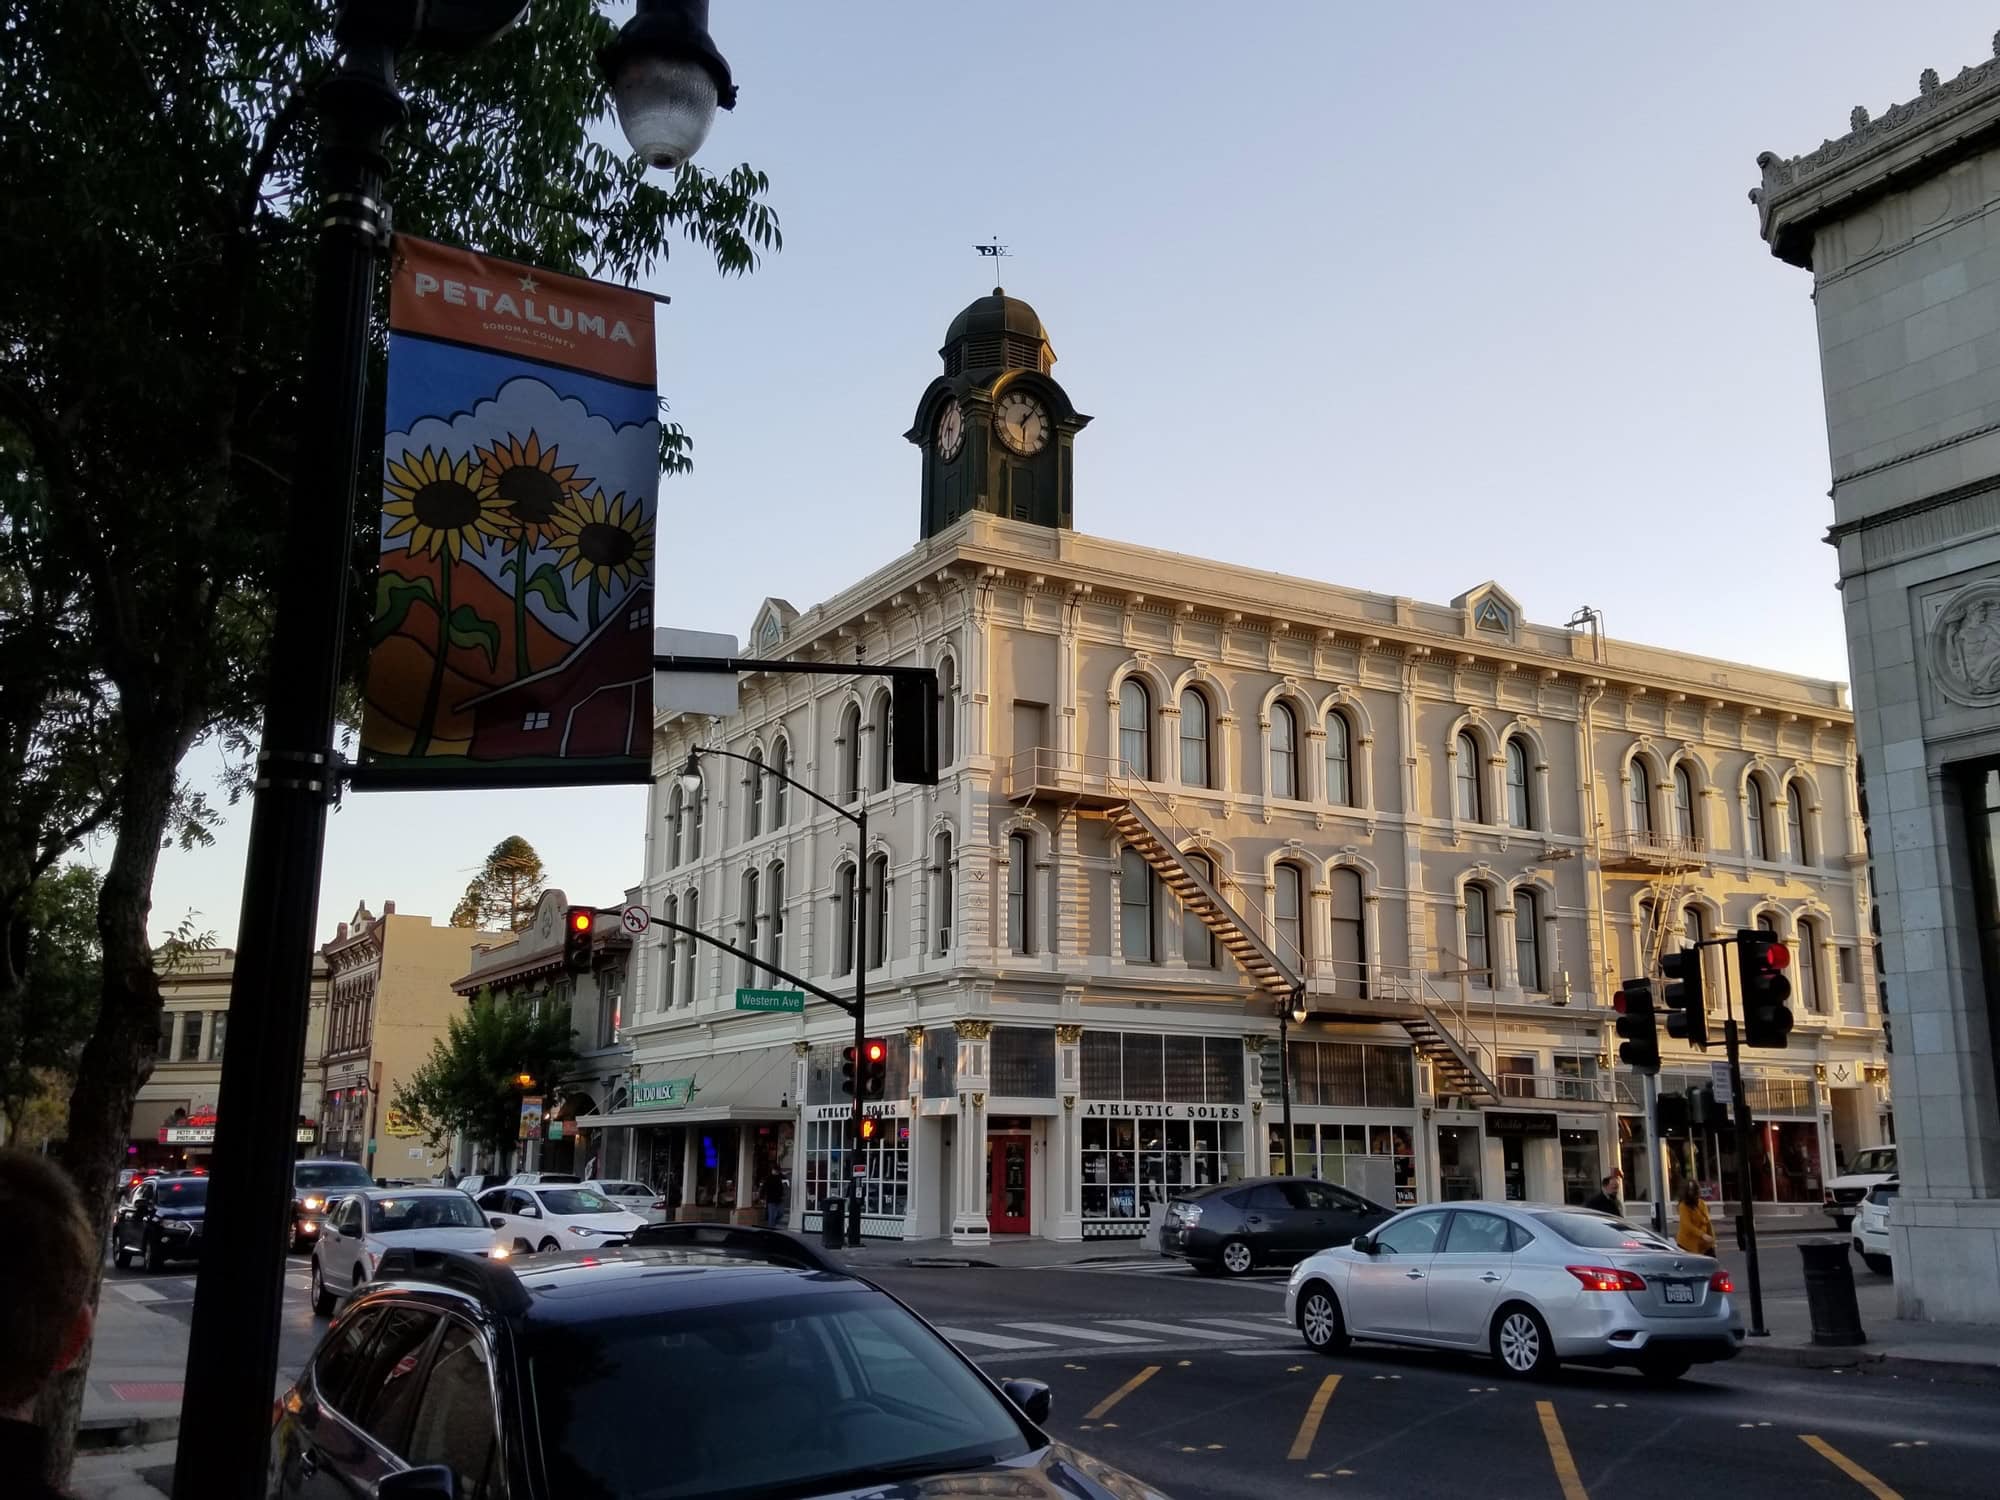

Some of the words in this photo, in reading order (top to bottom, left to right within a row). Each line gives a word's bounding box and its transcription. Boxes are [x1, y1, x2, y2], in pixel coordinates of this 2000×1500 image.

[415, 272, 636, 347] PETALUMA
[482, 321, 530, 336] SONOMA
[532, 329, 576, 350] COUNTY
[741, 993, 779, 1006] Western
[782, 996, 800, 1008] Ave
[817, 1106, 854, 1118] ATHLET
[866, 1104, 896, 1116] SOLES
[1087, 1104, 1174, 1117] ATHLETIC
[1187, 1106, 1240, 1119] SOLES
